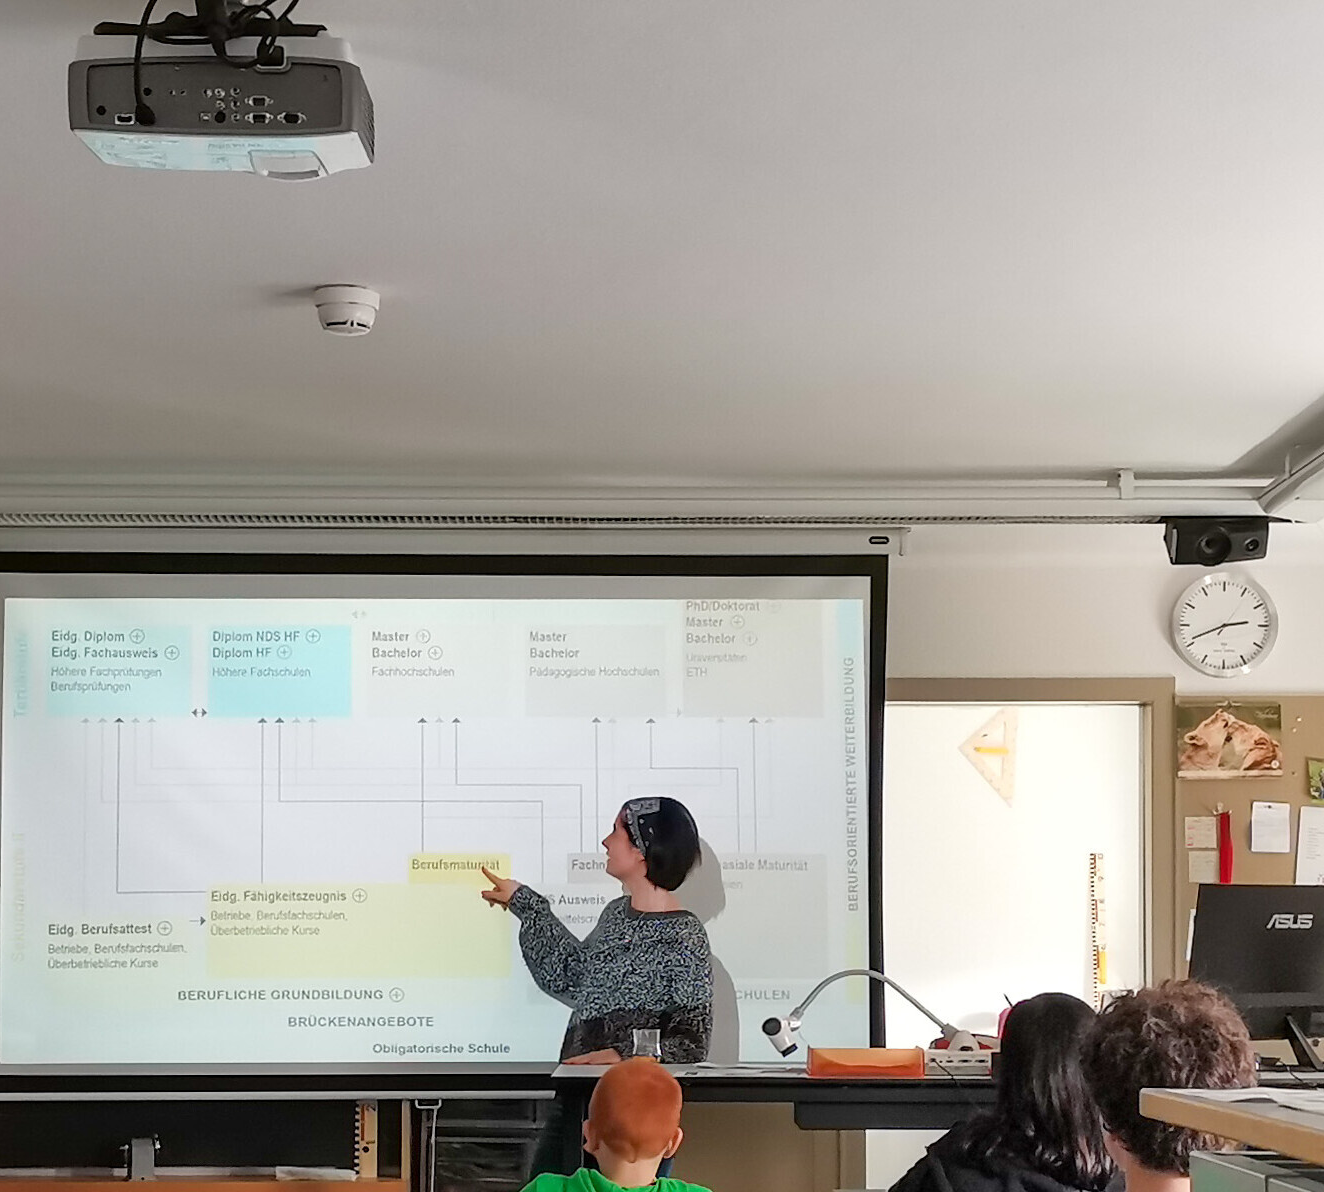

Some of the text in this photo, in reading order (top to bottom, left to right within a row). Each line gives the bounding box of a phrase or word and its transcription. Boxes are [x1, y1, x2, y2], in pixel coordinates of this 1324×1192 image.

[685, 616, 723, 628] Master
[51, 629, 125, 644] Eidg. Diplom
[212, 630, 300, 644] Diplom NDS HF
[371, 630, 410, 642] Master
[529, 630, 568, 642] Master
[685, 632, 736, 644] Bachelor
[51, 646, 159, 660] Eidg. Fachausweis
[212, 646, 273, 660] Diplom HF
[371, 646, 423, 659] Bachelor
[529, 646, 580, 659] Bachelor
[250, 665, 312, 678] Fachschulen
[371, 665, 456, 678] Fachhochschulen
[843, 656, 859, 912] BERUFSORIENTIERTE WEITERBILDUNG
[757, 858, 809, 872] Maturität
[210, 889, 347, 904] Eidg. Fähigkeitszeugnis
[1265, 913, 1314, 930] ASUS
[48, 923, 153, 938] Eidg. Berufsattest
[177, 988, 384, 1001] BERUFLICHE GRUNDBILDUNG
[287, 1013, 435, 1028] BRÜCKENANGEBOTE
[372, 1042, 512, 1055] Obligatorische Schule
